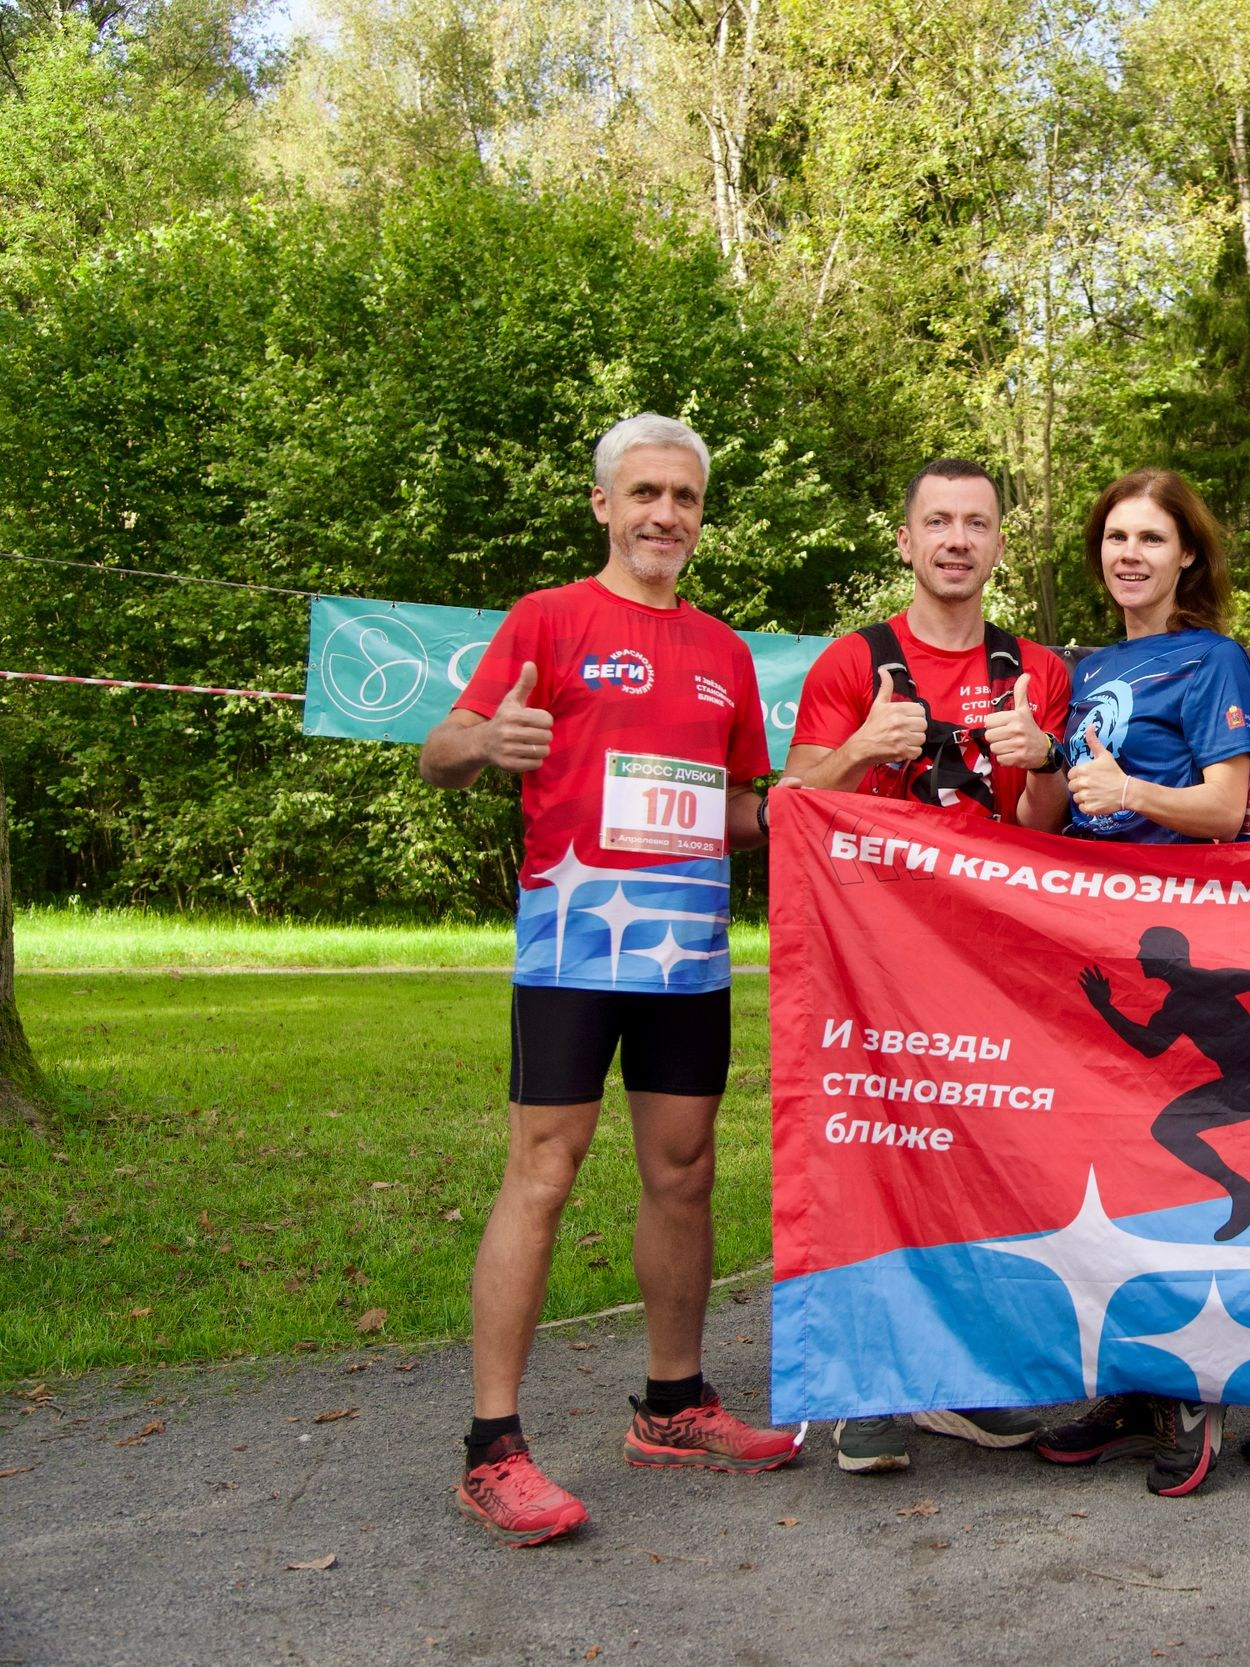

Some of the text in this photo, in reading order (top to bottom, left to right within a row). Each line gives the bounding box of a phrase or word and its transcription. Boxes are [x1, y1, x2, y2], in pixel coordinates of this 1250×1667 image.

[583, 663, 645, 681] БЕГИ
[959, 685, 971, 697] И
[621, 762, 717, 784] КРОСС ДУБКИ
[642, 787, 697, 829] 170
[677, 840, 715, 852] 14.09.25
[830, 830, 940, 874] БЕГИ
[821, 1018, 1011, 1063] И звезды
[822, 1072, 1055, 1111] становятся
[825, 1111, 954, 1151] ближе
